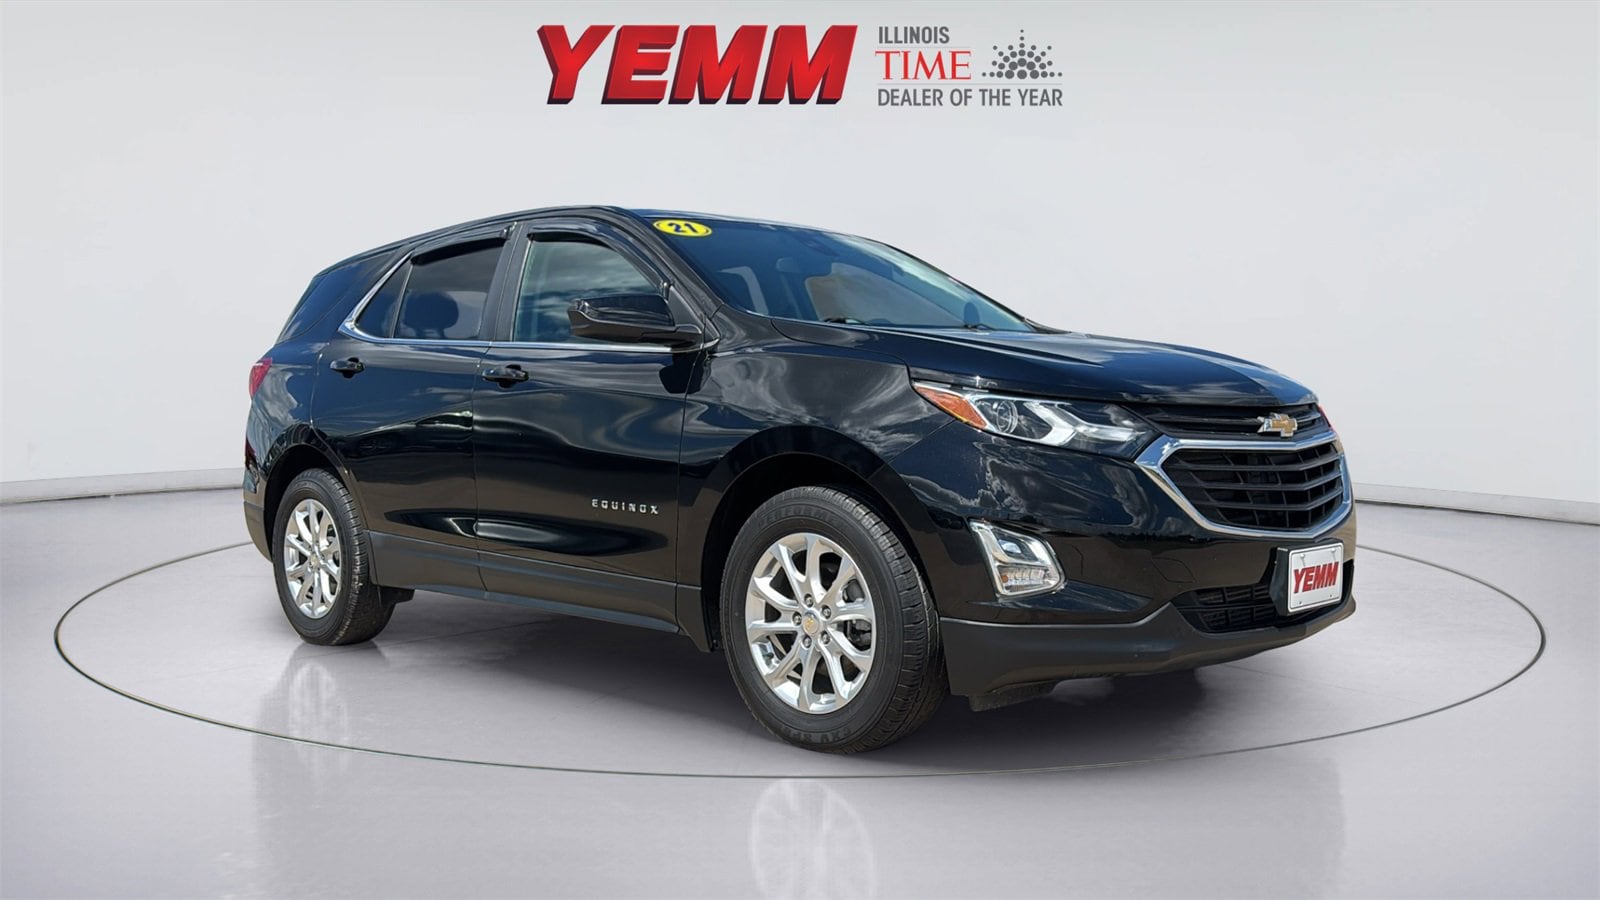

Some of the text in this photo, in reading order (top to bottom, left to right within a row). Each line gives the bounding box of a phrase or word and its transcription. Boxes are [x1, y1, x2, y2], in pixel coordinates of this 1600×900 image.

[667, 221, 700, 234] 21
[591, 498, 659, 515] EQUINOX
[1293, 561, 1339, 594] YEMM
